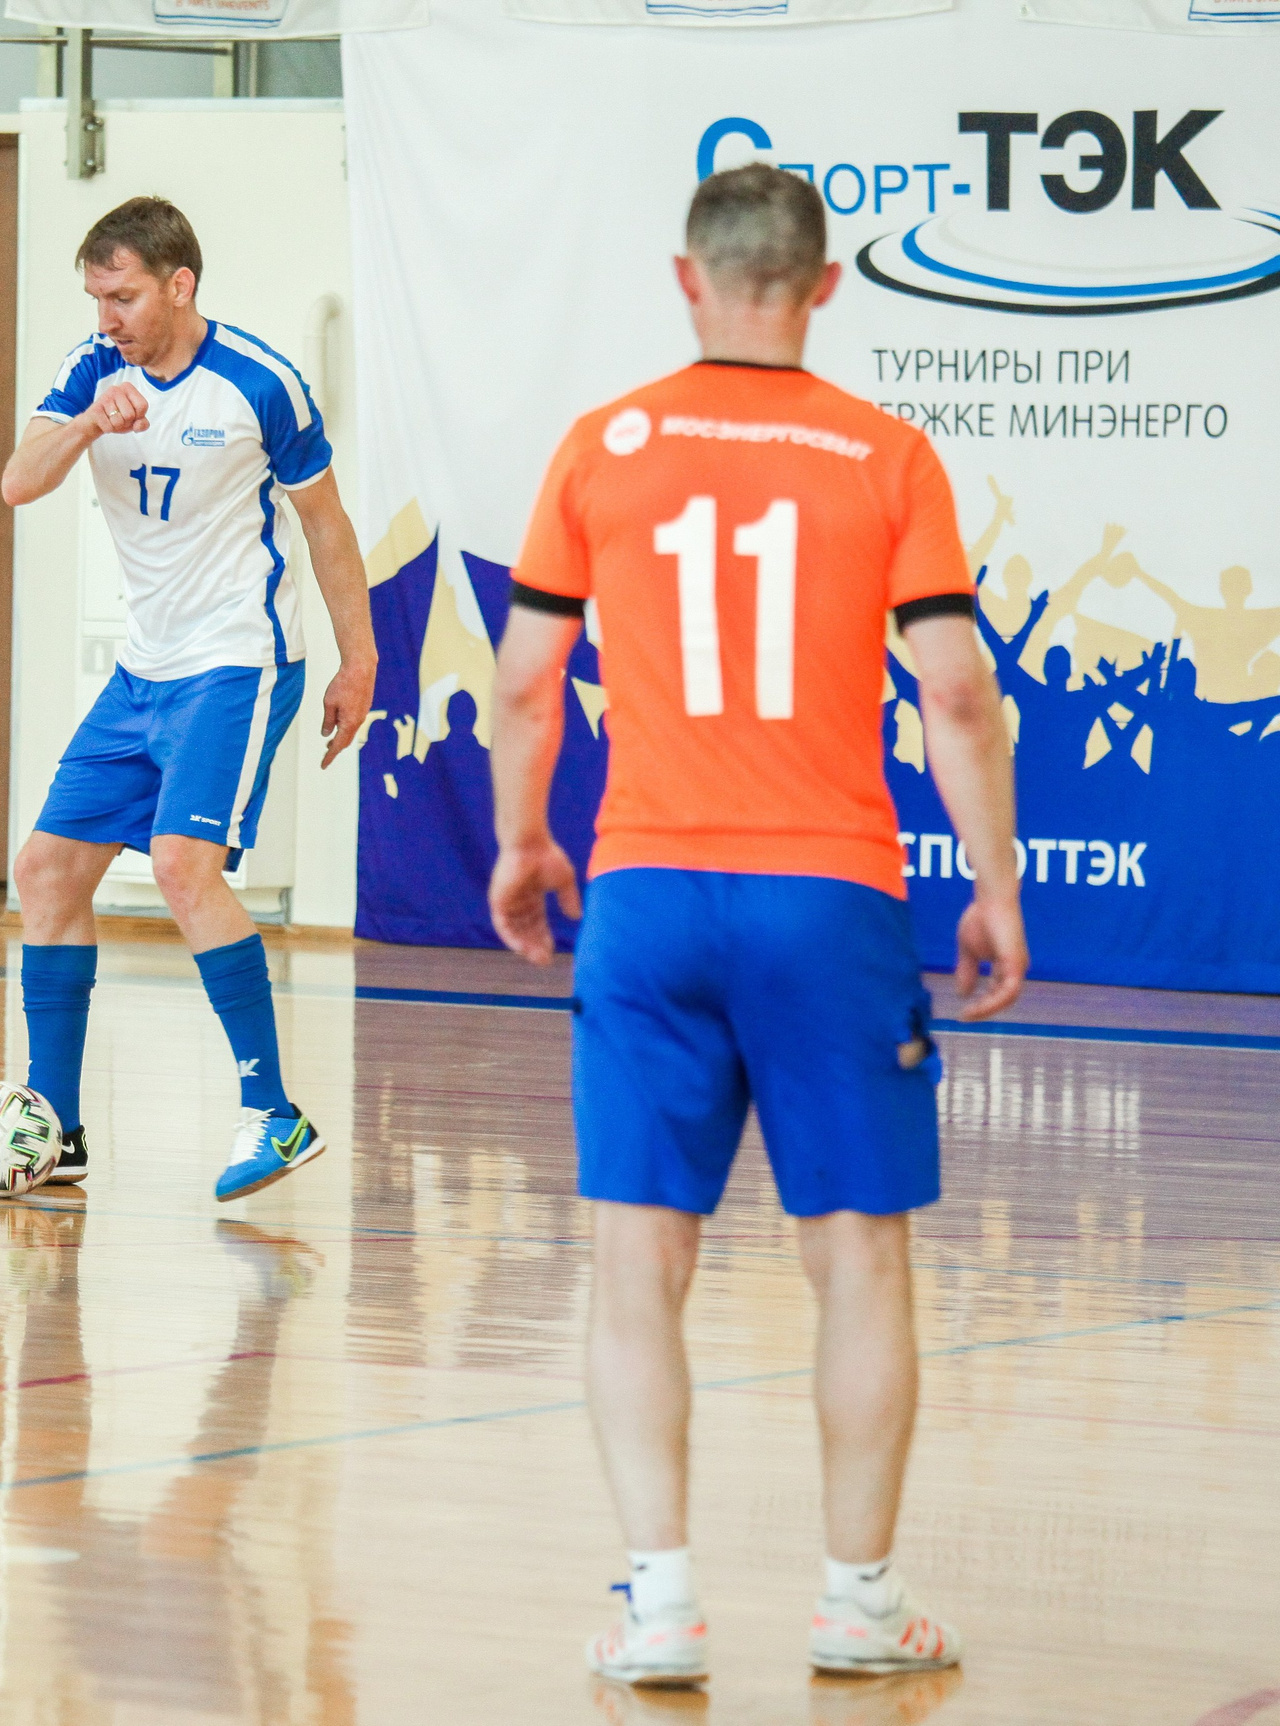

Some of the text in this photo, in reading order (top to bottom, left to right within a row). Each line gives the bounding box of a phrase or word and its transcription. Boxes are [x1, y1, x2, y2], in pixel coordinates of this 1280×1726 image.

[871, 350, 1130, 383] ТУРНИРЫ ПРИ
[1009, 403, 1229, 439] МИНЭНЕРГО
[129, 463, 181, 522] 17
[653, 495, 798, 720] 11
